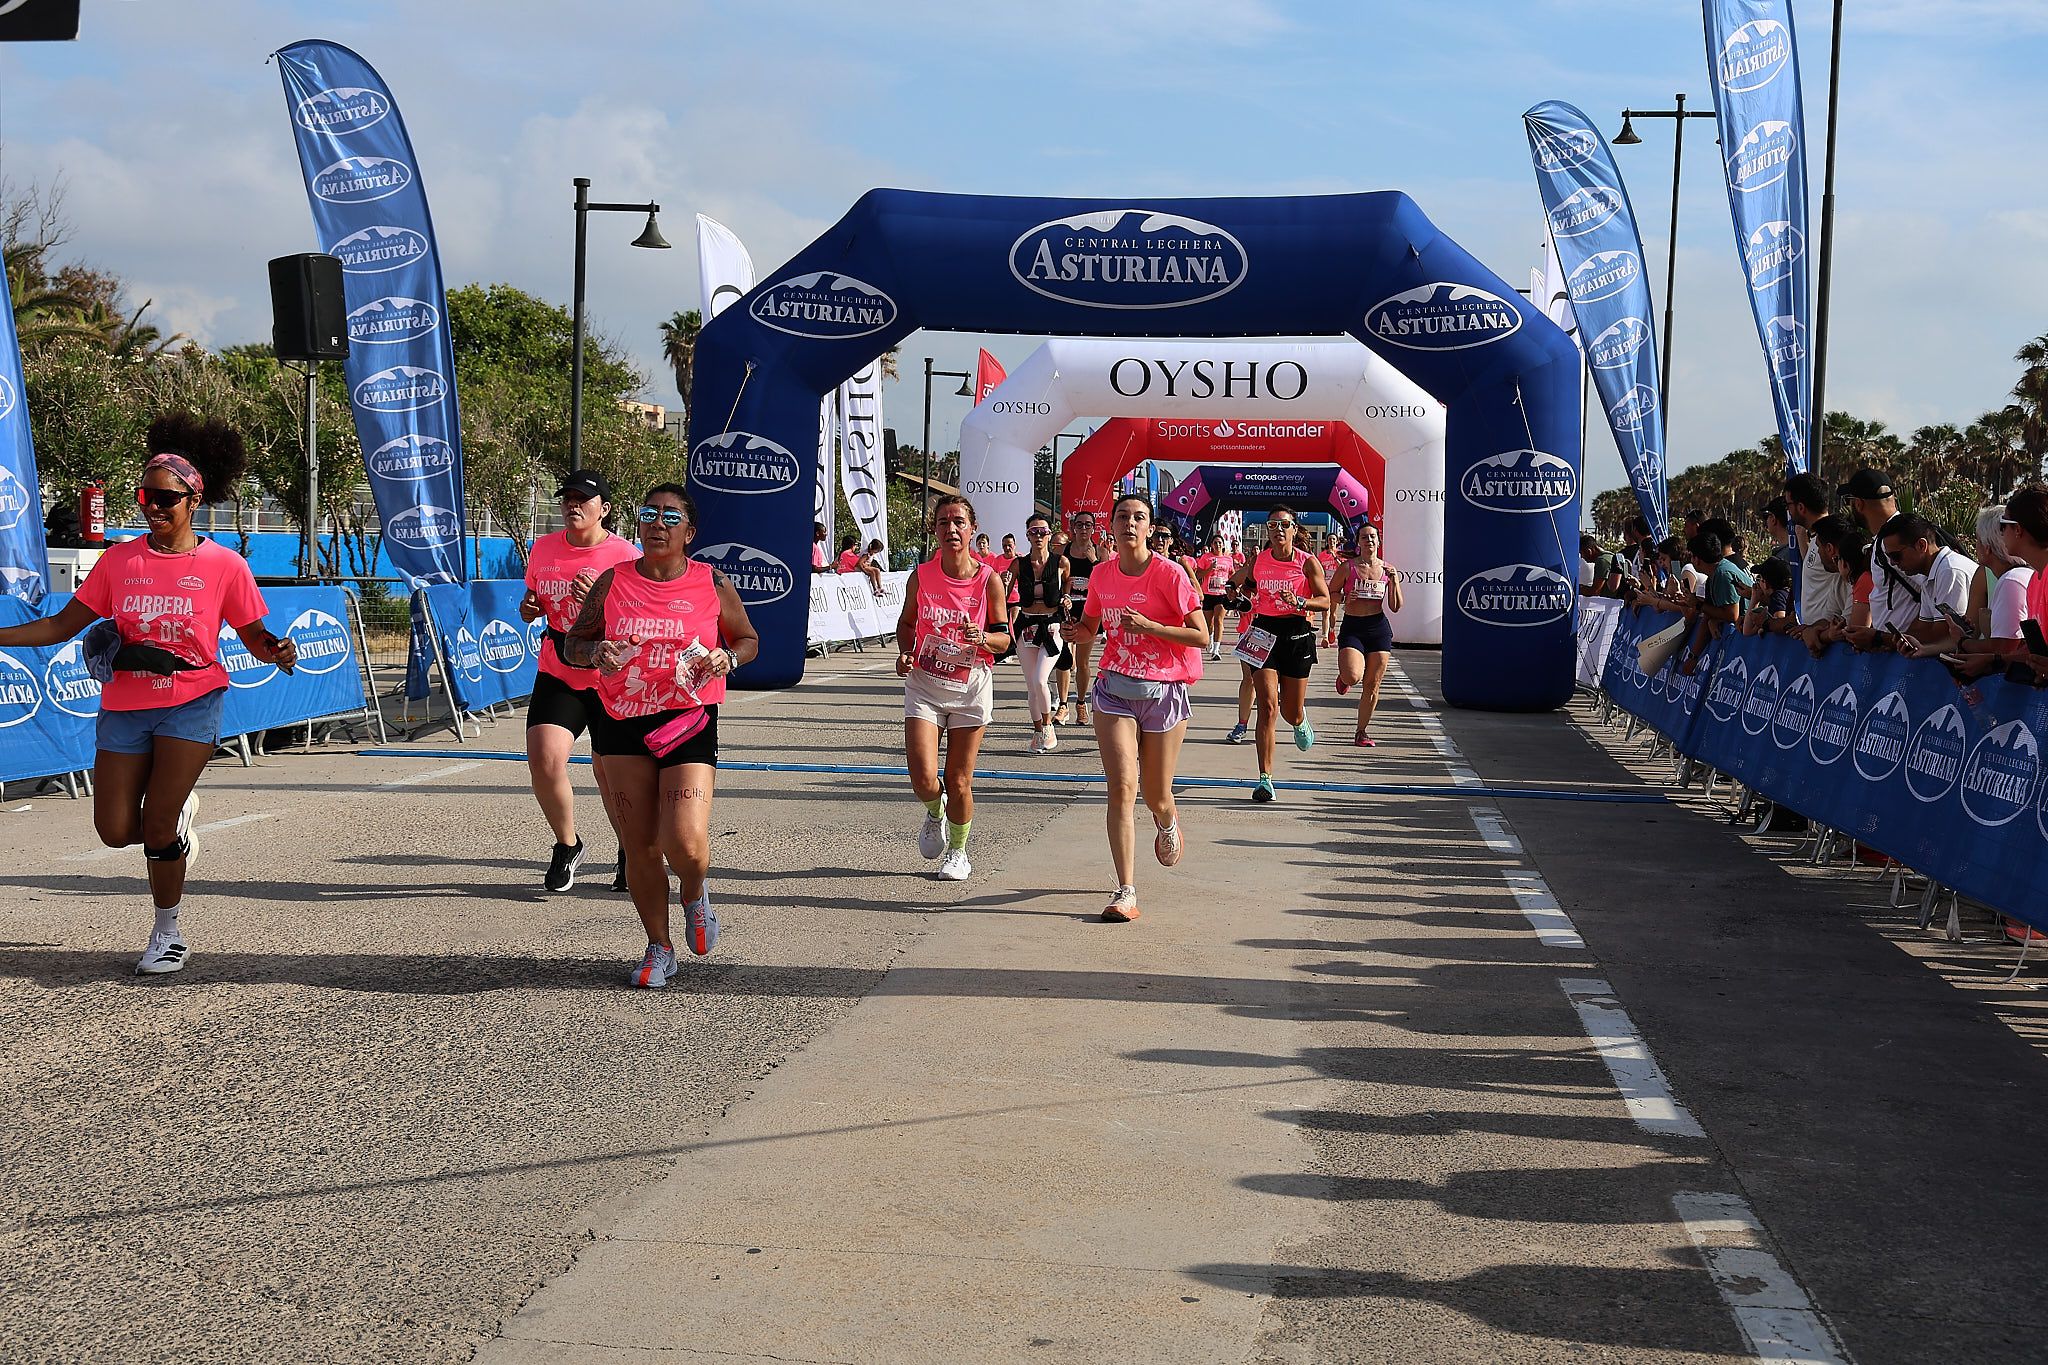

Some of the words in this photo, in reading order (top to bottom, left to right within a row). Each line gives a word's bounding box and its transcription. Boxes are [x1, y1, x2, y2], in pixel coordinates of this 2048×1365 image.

[1065, 238, 1138, 248] CENTRAL
[1147, 240, 1222, 250] LECHERA
[1027, 238, 1230, 284] ASTURIANA
[758, 294, 884, 324] ASTURIANA
[783, 292, 829, 301] CENTRAL
[835, 296, 883, 306] LECHERA
[1398, 306, 1450, 316] CENTRAL
[1455, 303, 1504, 313] LECHERA
[1378, 312, 1513, 336] ASTURIANA
[1110, 358, 1308, 400] OYSHO
[993, 402, 1050, 414] OYSHO
[1366, 405, 1426, 418] OYSHO
[1158, 422, 1210, 440] Sports
[1237, 423, 1324, 438] Santander
[694, 453, 792, 482] ASTURIANA
[748, 454, 790, 464] LECHERA
[1245, 474, 1277, 482] octopus
[1278, 474, 1304, 483] energy
[1468, 473, 1572, 497] ASTURIANA
[1534, 471, 1570, 480] LECHERA
[966, 481, 1019, 494] OYSHO
[1074, 499, 1098, 507] Sports
[742, 565, 783, 575] LECHERA
[1260, 580, 1294, 590] CARRERA
[1483, 584, 1526, 592] CENTRAL
[122, 595, 193, 615] CARRERA
[1464, 586, 1568, 611] ASTURIANA
[160, 621, 182, 642] DE
[615, 616, 685, 638] CARRERA
[484, 641, 522, 661] ASTURIANA
[648, 643, 674, 669] DE
[152, 678, 172, 689] 2026
[1812, 709, 1850, 747] ASTURIANA
[1856, 720, 1902, 763] ASTURIANA
[1908, 734, 1957, 782] ASTURIANA
[1964, 751, 2030, 805] ASTURIANA
